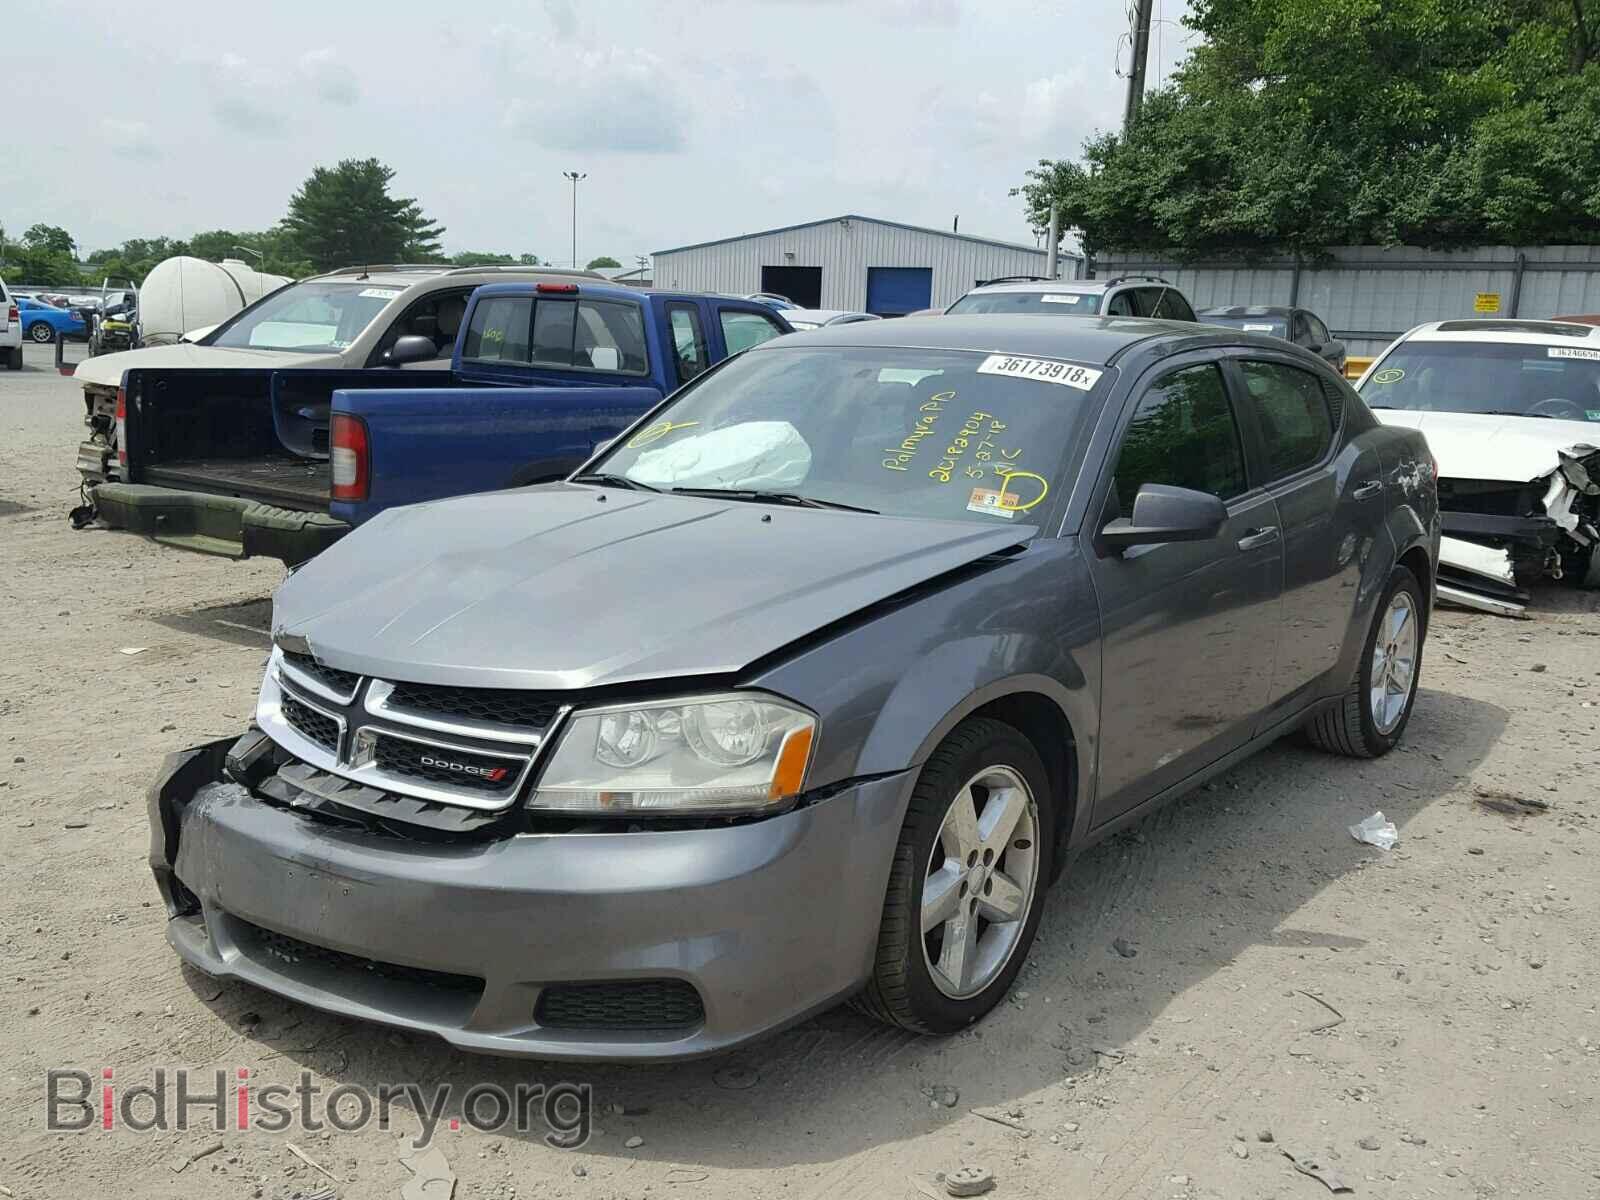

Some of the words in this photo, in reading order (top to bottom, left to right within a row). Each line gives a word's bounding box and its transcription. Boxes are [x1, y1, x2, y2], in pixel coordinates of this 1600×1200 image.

[882, 415, 939, 471] Palmyra
[919, 391, 956, 411] PD
[988, 495, 997, 505] 3
[421, 756, 493, 778] DODGE
